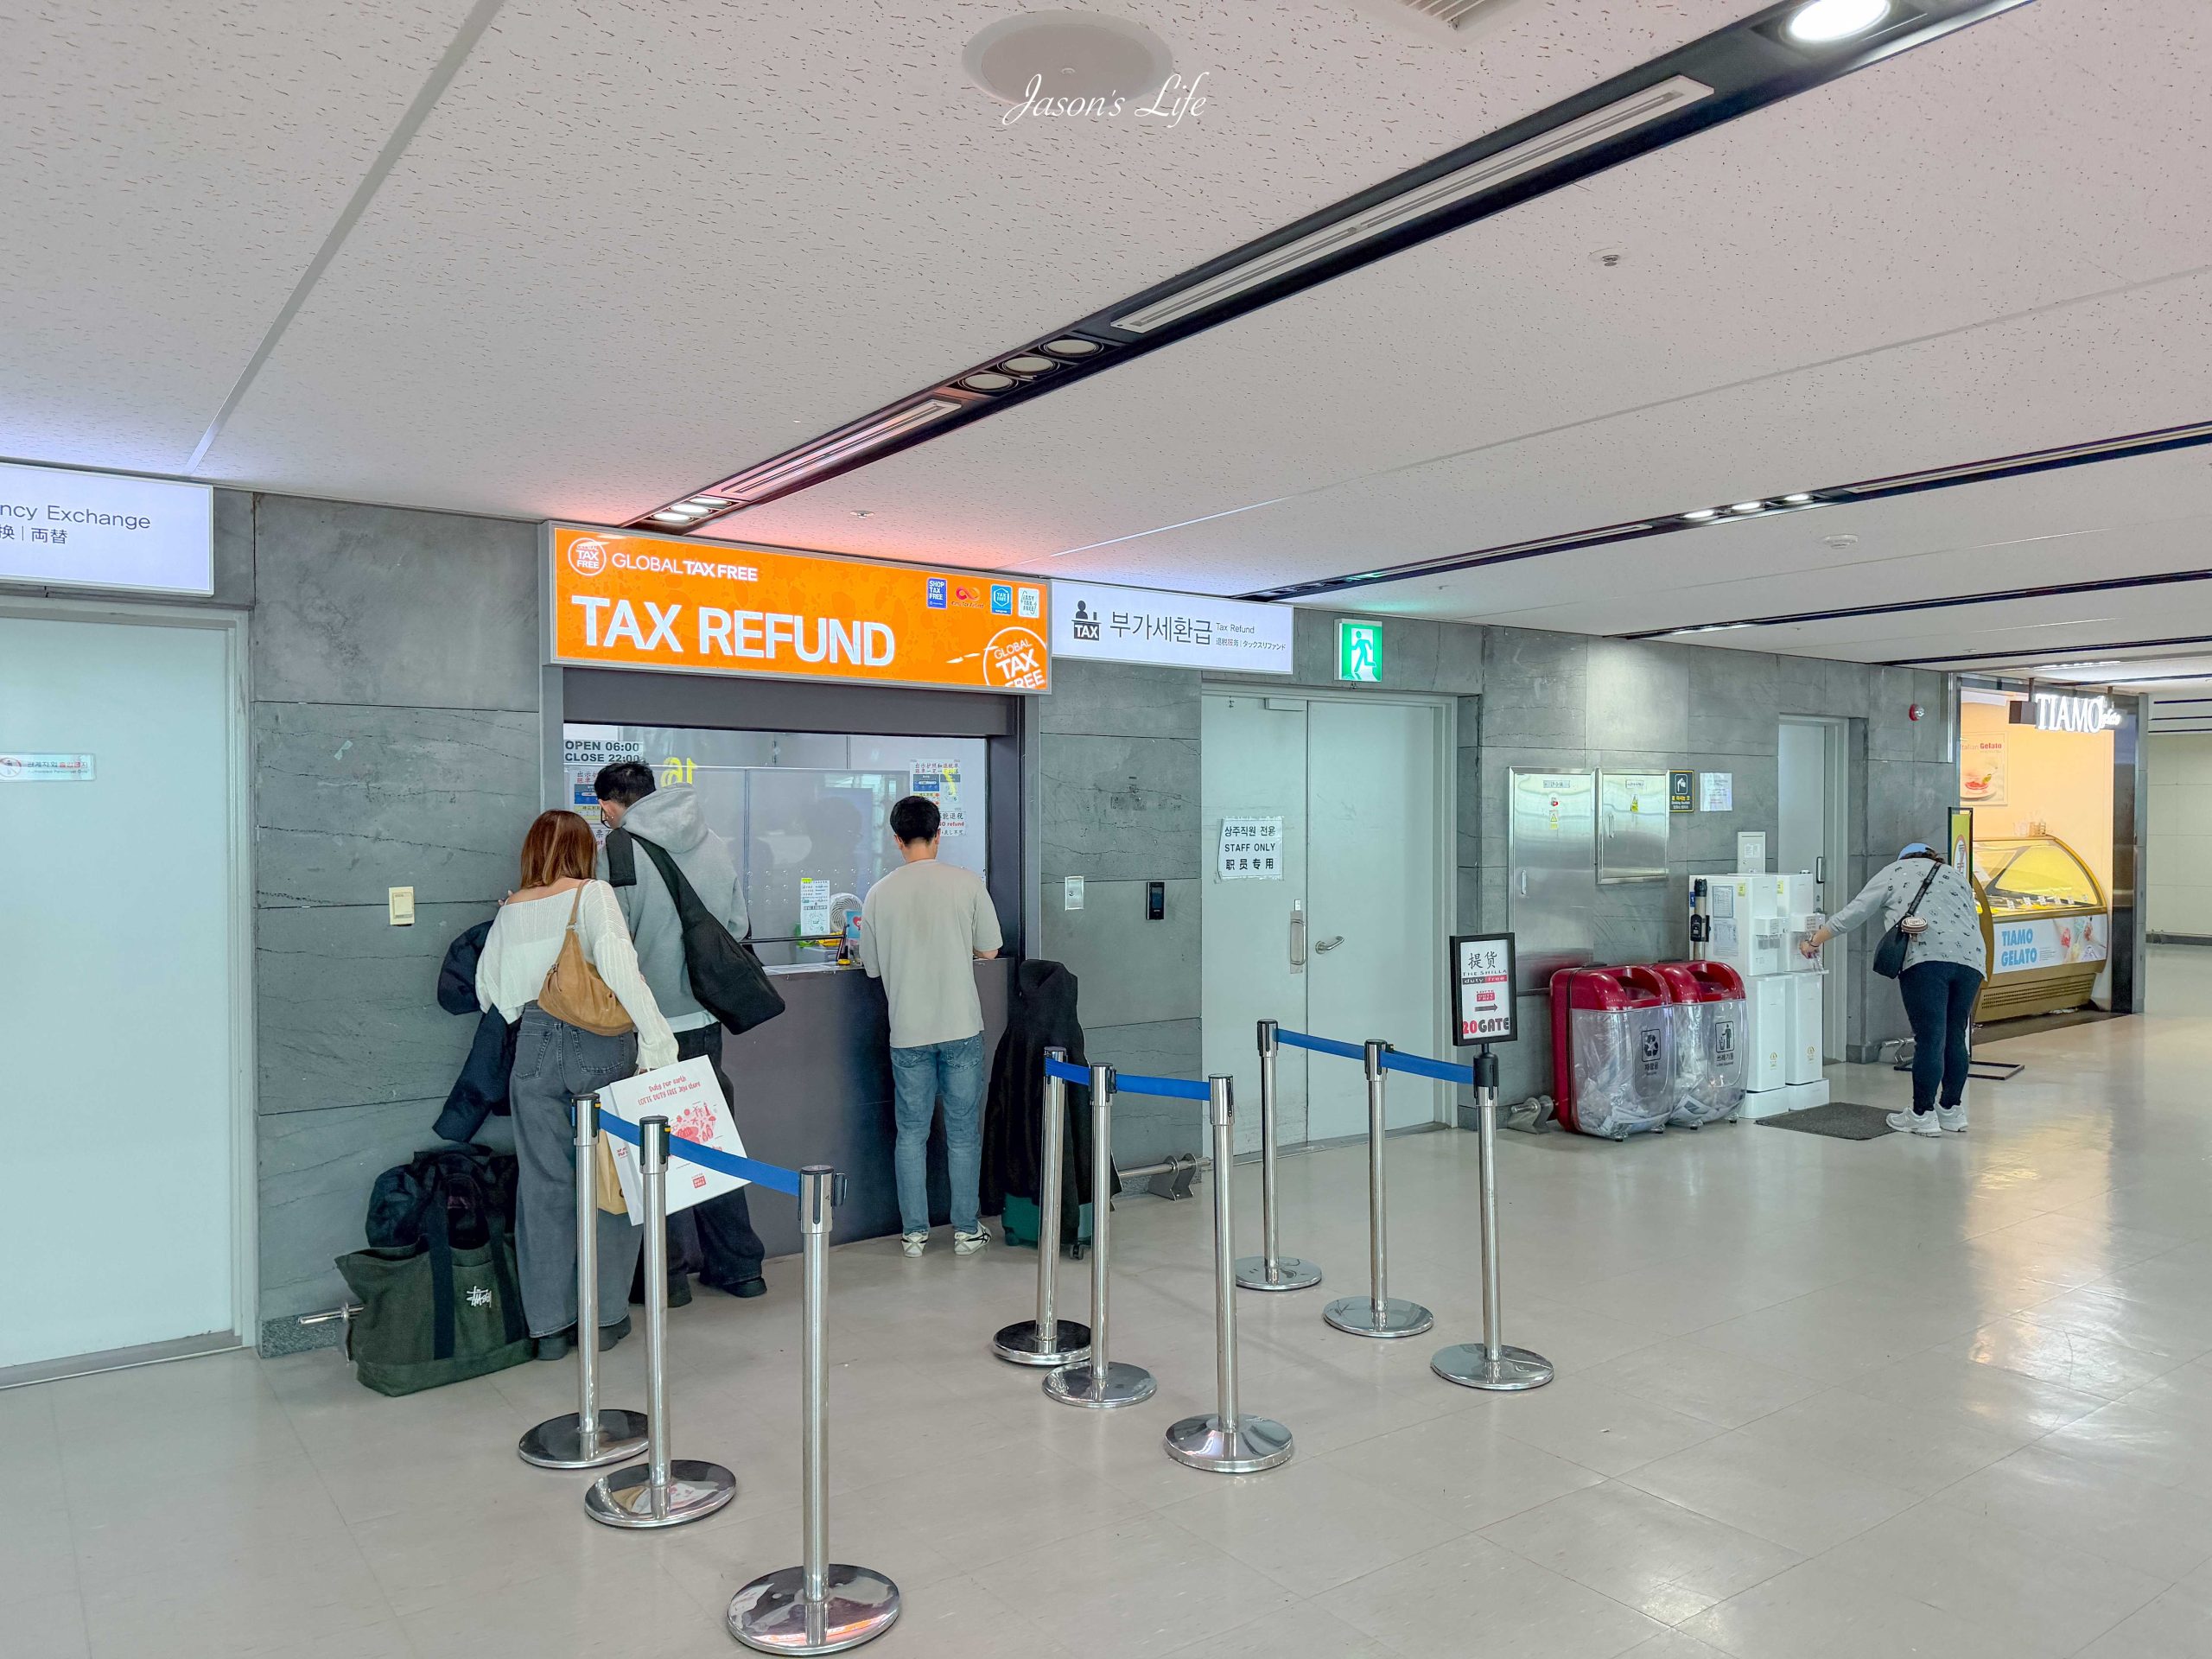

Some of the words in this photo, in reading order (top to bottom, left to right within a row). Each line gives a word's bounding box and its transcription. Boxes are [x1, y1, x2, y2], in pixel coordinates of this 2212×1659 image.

[48, 505, 151, 531] Exchange
[576, 549, 599, 561] TAX
[576, 560, 600, 569] FREE
[612, 552, 683, 575] GLOBAL
[683, 560, 715, 577] TAX
[717, 564, 758, 582] FREE
[571, 594, 684, 652] TAX
[698, 607, 895, 666] REFUND
[1075, 624, 1098, 639] TAX
[1110, 611, 1212, 645] 부가세환급
[1216, 622, 1228, 631] Tax
[1230, 624, 1255, 634] Refund
[994, 639, 1032, 659] GLOBAL
[995, 648, 1039, 680] TAX
[2035, 693, 2102, 733] TIAMO
[565, 741, 601, 750] OPEN
[606, 741, 639, 751] 06:00
[565, 753, 605, 762] CLOSE
[608, 754, 640, 763] 22:00
[1225, 826, 1255, 836] 상주직원
[1261, 826, 1275, 836] 전용
[1225, 843, 1250, 852] STAFF
[1226, 858, 1274, 870] 职员专用
[2001, 928, 2033, 947] TIAMO
[1468, 951, 1497, 969] 提货
[2001, 947, 2037, 967] GELATO
[648, 1084, 662, 1092] Duty
[663, 1080, 671, 1089] for
[673, 1076, 687, 1084] earth
[638, 1096, 652, 1106] LOTTE
[652, 1090, 666, 1101] DUTY
